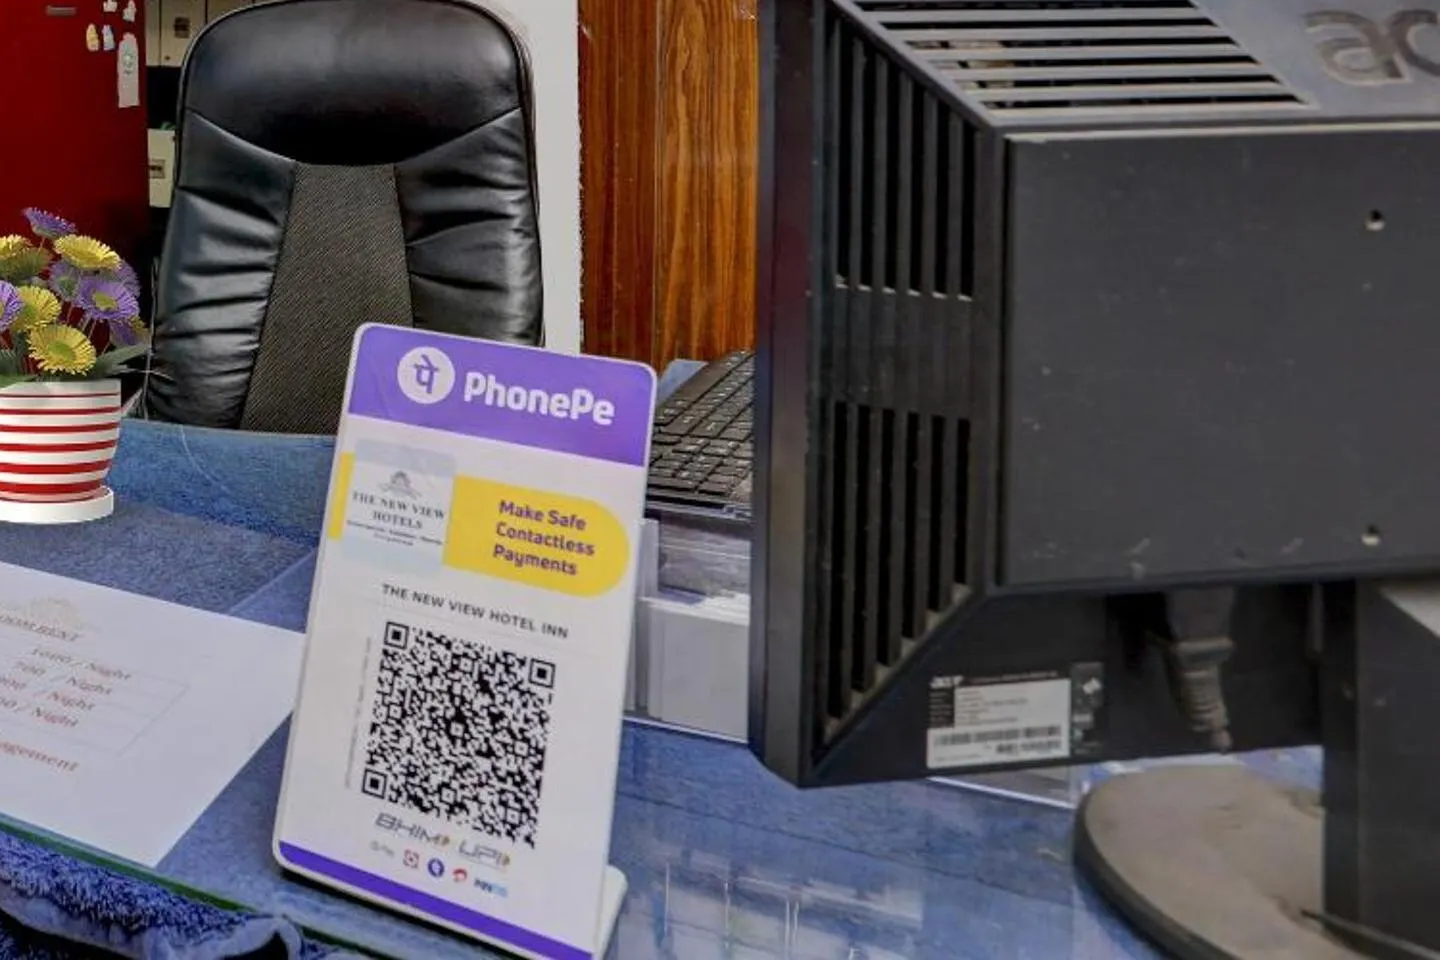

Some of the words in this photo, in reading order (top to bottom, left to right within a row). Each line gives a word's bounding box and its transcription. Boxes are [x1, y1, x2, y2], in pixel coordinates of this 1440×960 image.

[464, 371, 617, 427] PhonePe
[352, 490, 377, 506] THE
[380, 496, 409, 514] NEW
[412, 503, 446, 520] VIEW
[373, 510, 423, 531] HOTELS
[499, 499, 545, 523] Make
[547, 508, 587, 531] Safe
[496, 521, 596, 556] Contactless
[493, 544, 577, 576] Payments
[382, 583, 408, 600] THE
[411, 591, 444, 609] NEW
[449, 600, 485, 619] VIEW
[489, 610, 536, 631] HOTEL
[541, 622, 569, 639] INN
